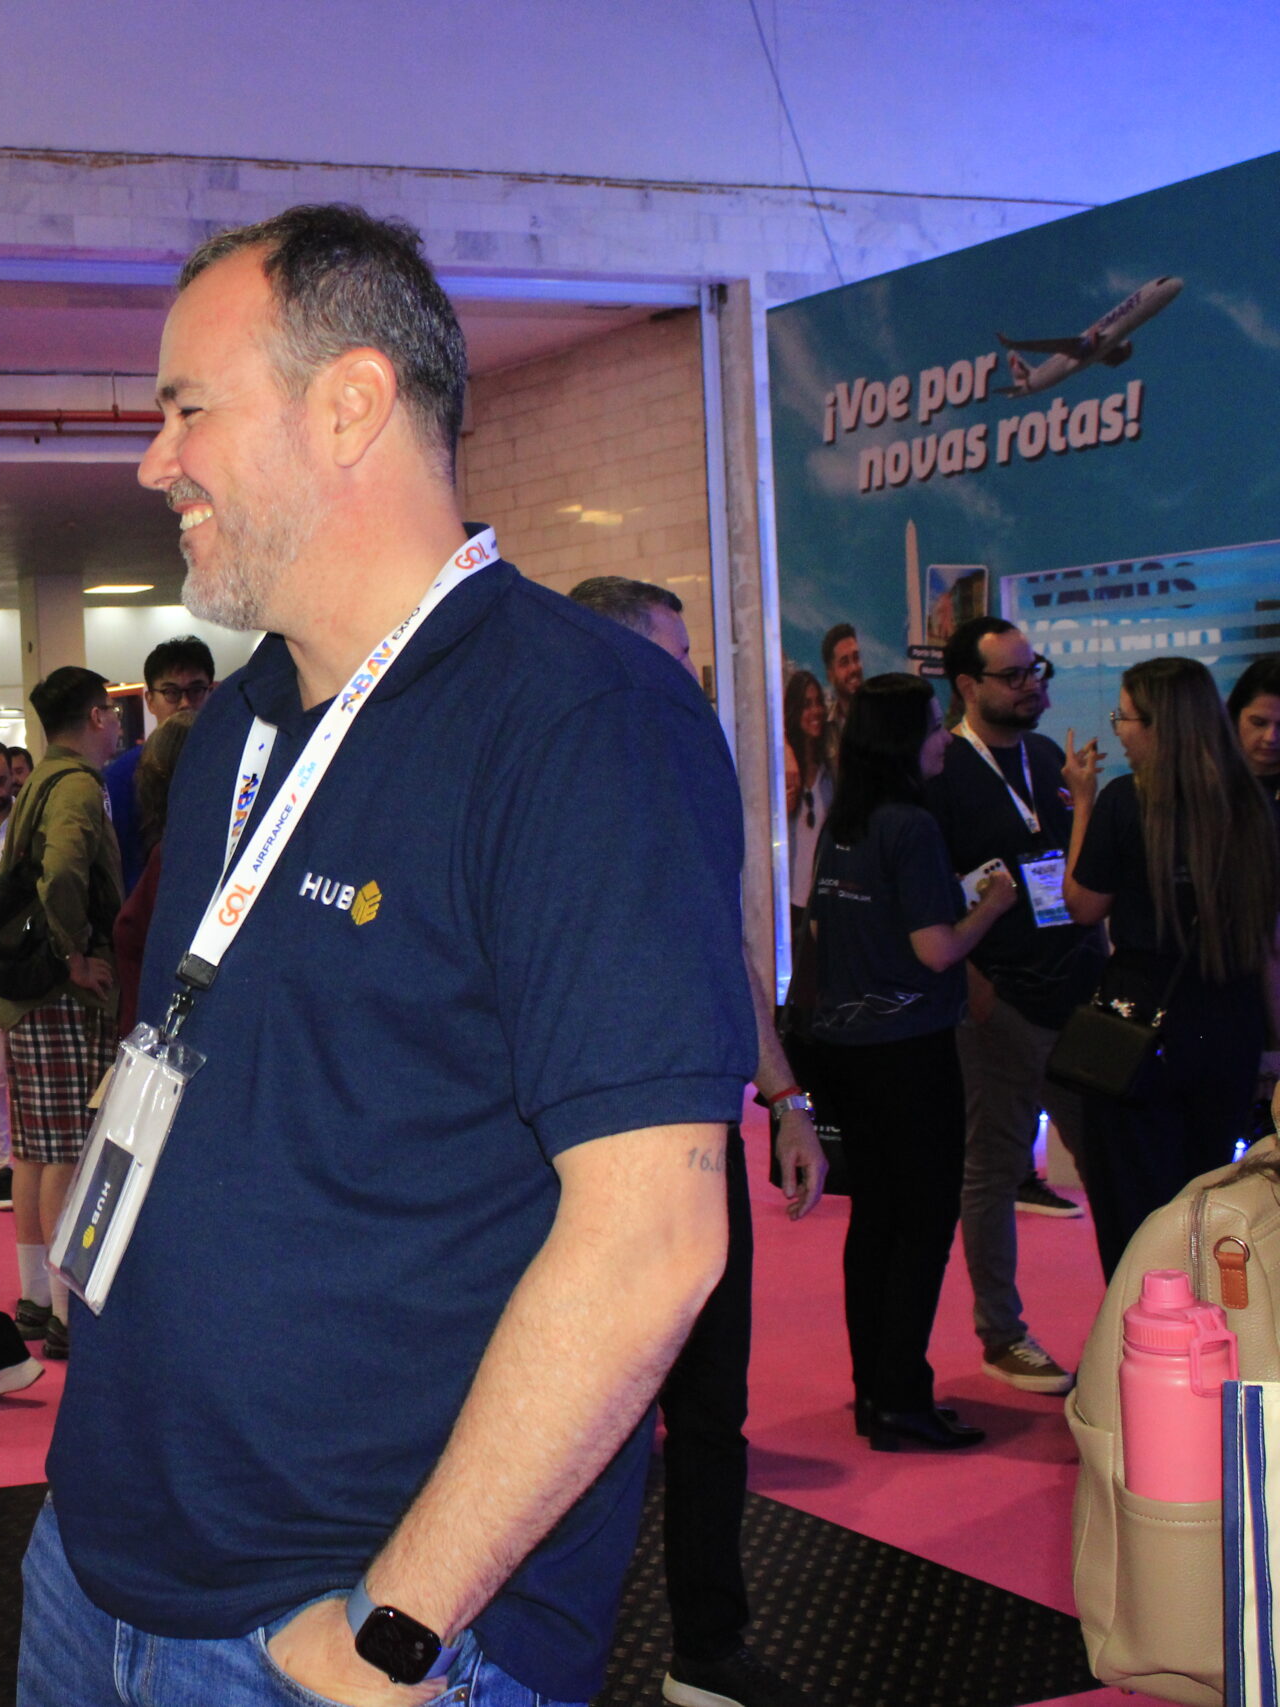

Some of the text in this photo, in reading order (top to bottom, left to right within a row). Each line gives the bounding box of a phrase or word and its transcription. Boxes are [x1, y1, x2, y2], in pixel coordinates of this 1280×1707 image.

[823, 352, 997, 443] ¡Voe por
[859, 379, 1143, 491] novas rotas!
[454, 542, 490, 570] GOL
[341, 606, 420, 714] ABAV EXPO
[218, 761, 317, 926] GOL AIRFRANCE KLM
[298, 872, 356, 911] HUB
[91, 1181, 111, 1225] HUB
